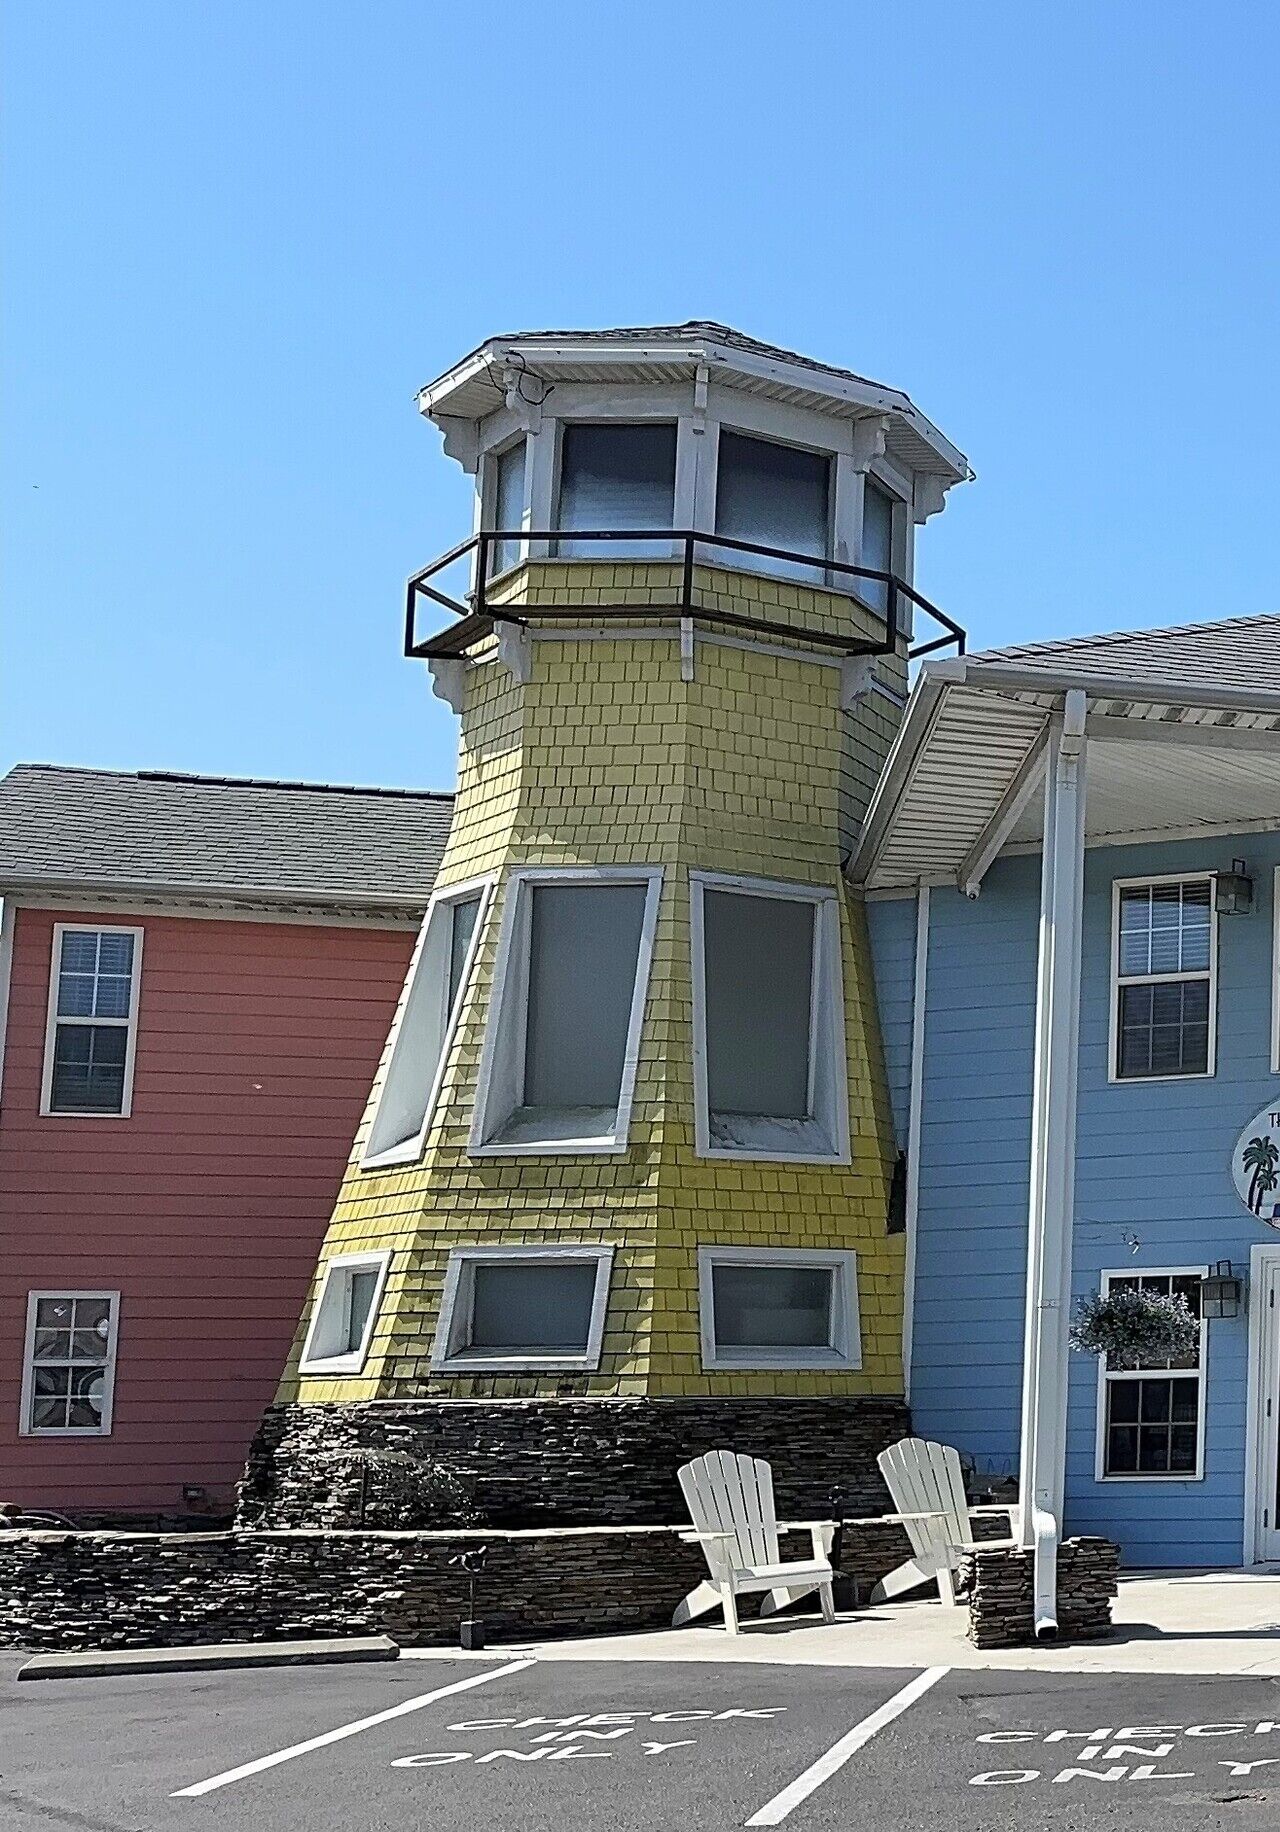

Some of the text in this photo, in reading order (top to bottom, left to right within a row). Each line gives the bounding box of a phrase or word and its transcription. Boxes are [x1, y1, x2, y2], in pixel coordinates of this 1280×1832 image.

[446, 1707, 788, 1731] CHECK
[529, 1727, 635, 1744] IN
[389, 1740, 698, 1768] ONLY
[1076, 1743, 1175, 1761] IN
[968, 1758, 1280, 1786] ONLY
